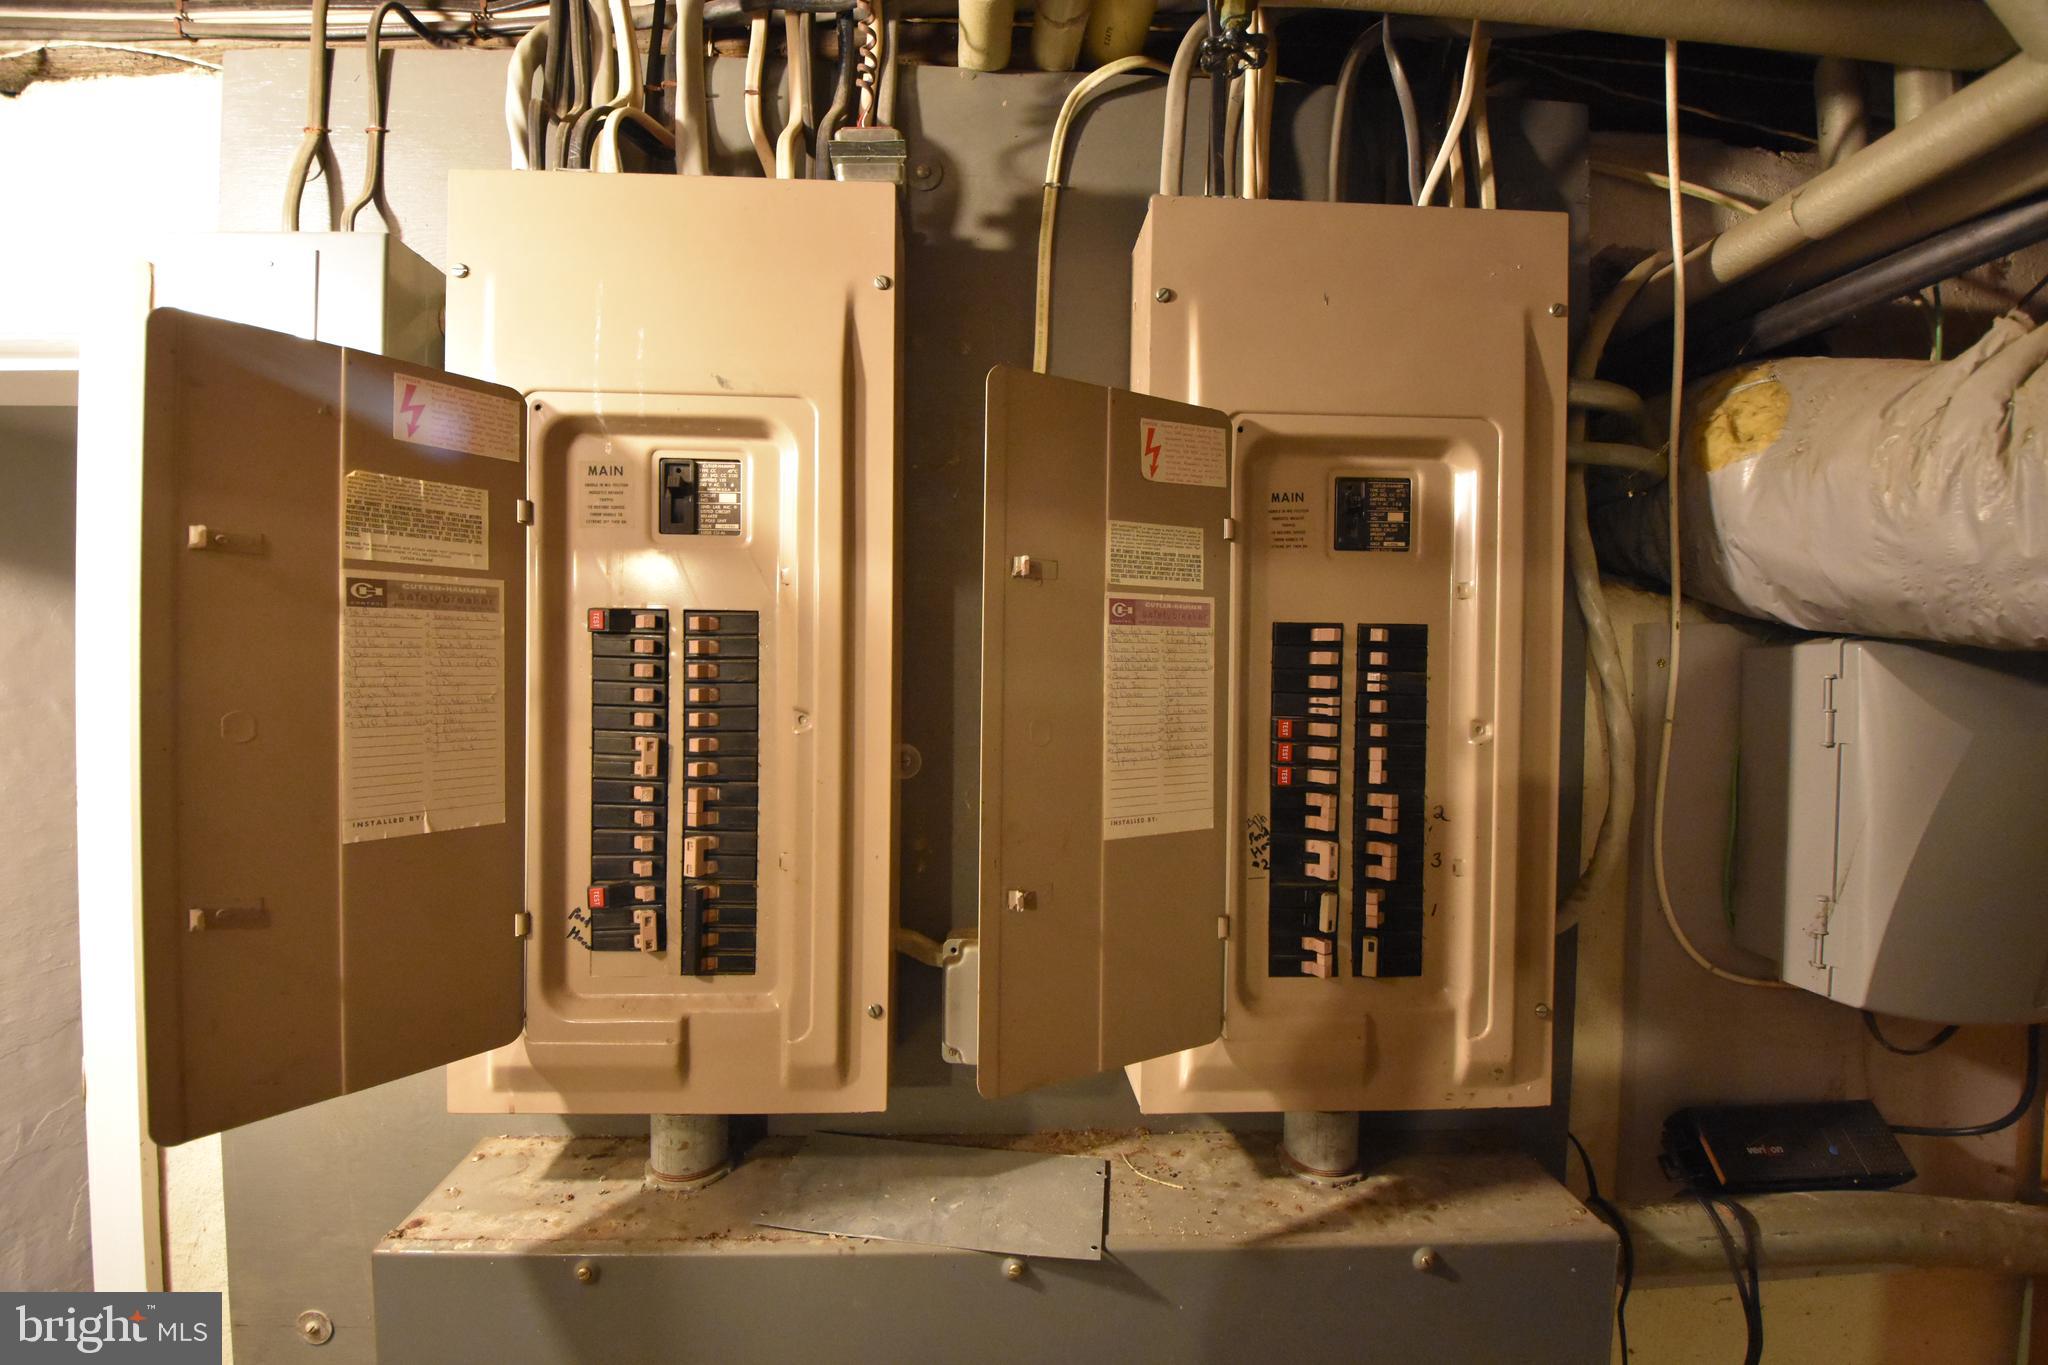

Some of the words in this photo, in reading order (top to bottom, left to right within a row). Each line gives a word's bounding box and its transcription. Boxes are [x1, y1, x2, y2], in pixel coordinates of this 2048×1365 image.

[588, 465, 624, 476] MAIN
[1271, 492, 1305, 503] MAIN
[402, 583, 487, 594] CUTLER-HAMMER
[1433, 804, 1450, 822] 2
[352, 816, 405, 828] INSTALLED
[1110, 817, 1145, 826] INSTALLED
[1430, 851, 1442, 868] 3
